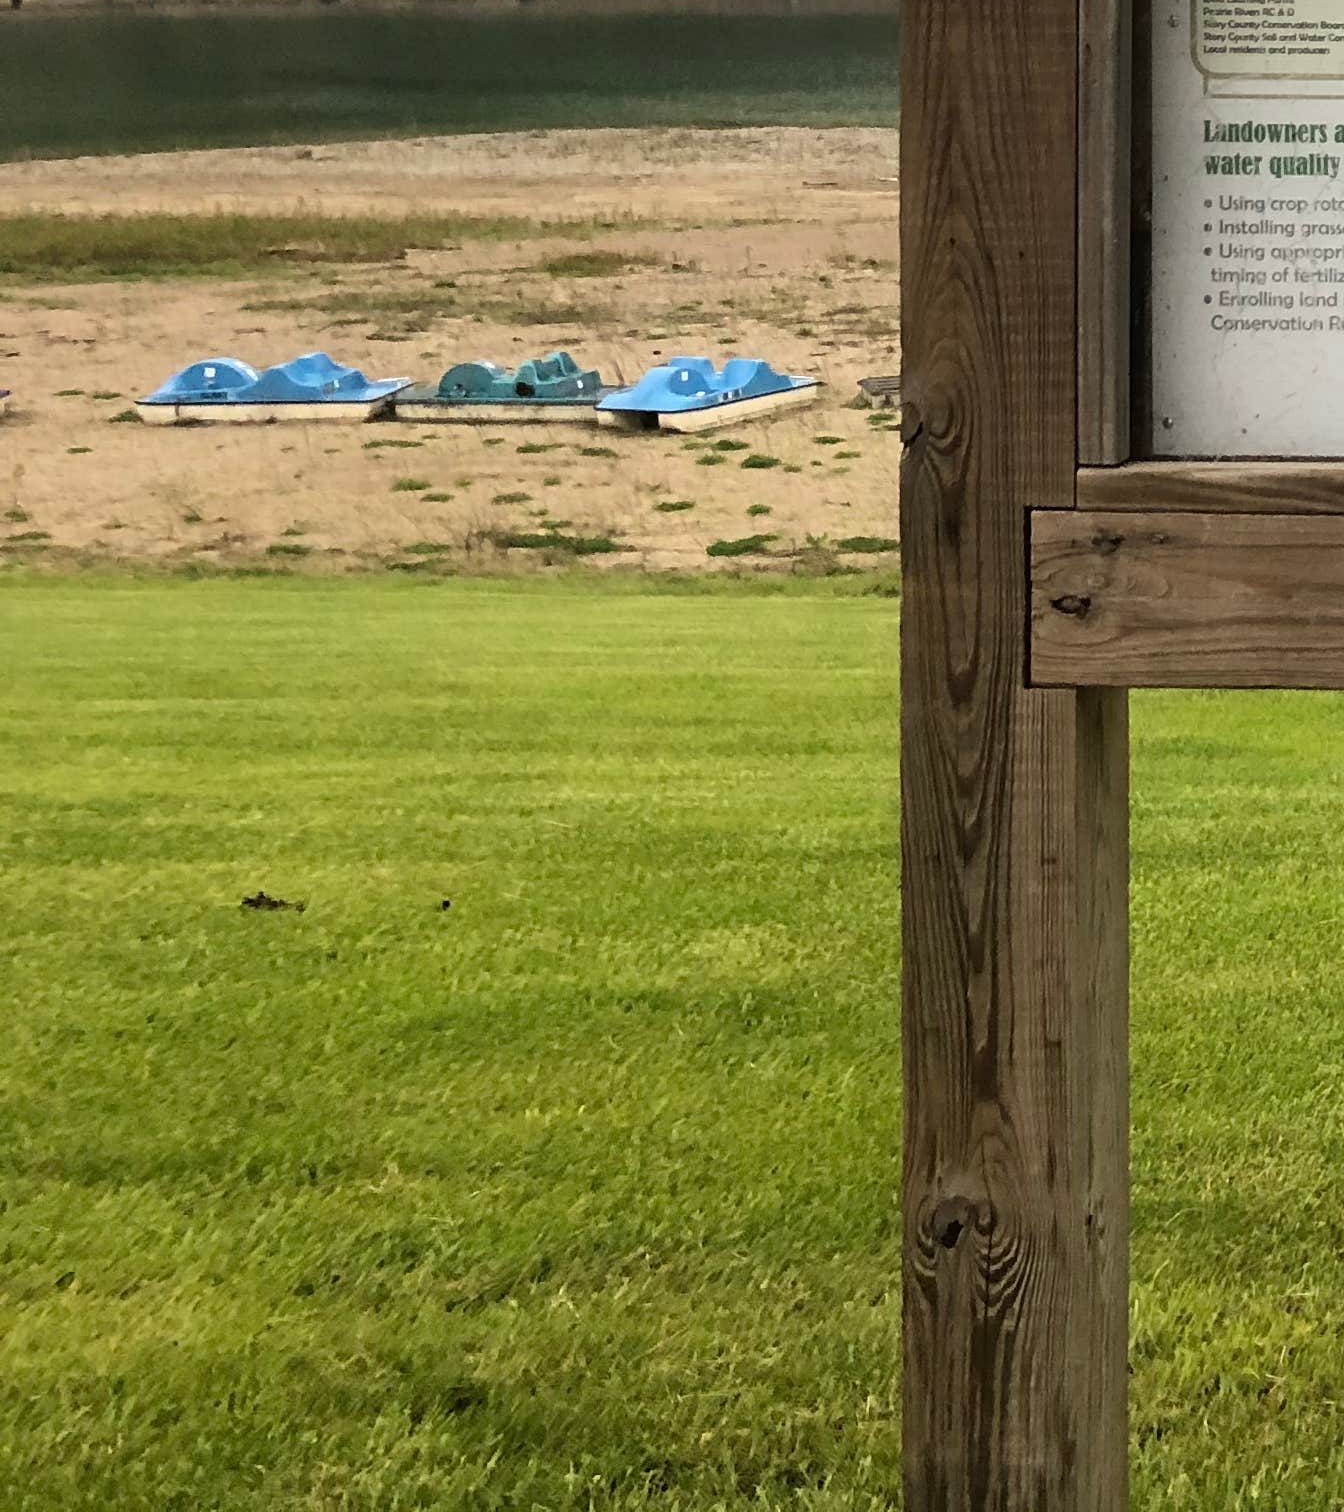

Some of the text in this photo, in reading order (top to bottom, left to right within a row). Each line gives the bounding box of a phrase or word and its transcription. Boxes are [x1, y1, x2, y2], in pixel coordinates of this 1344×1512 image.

[1204, 120, 1326, 143] Landowners
[1204, 153, 1262, 174] water
[1269, 153, 1339, 178] quality
